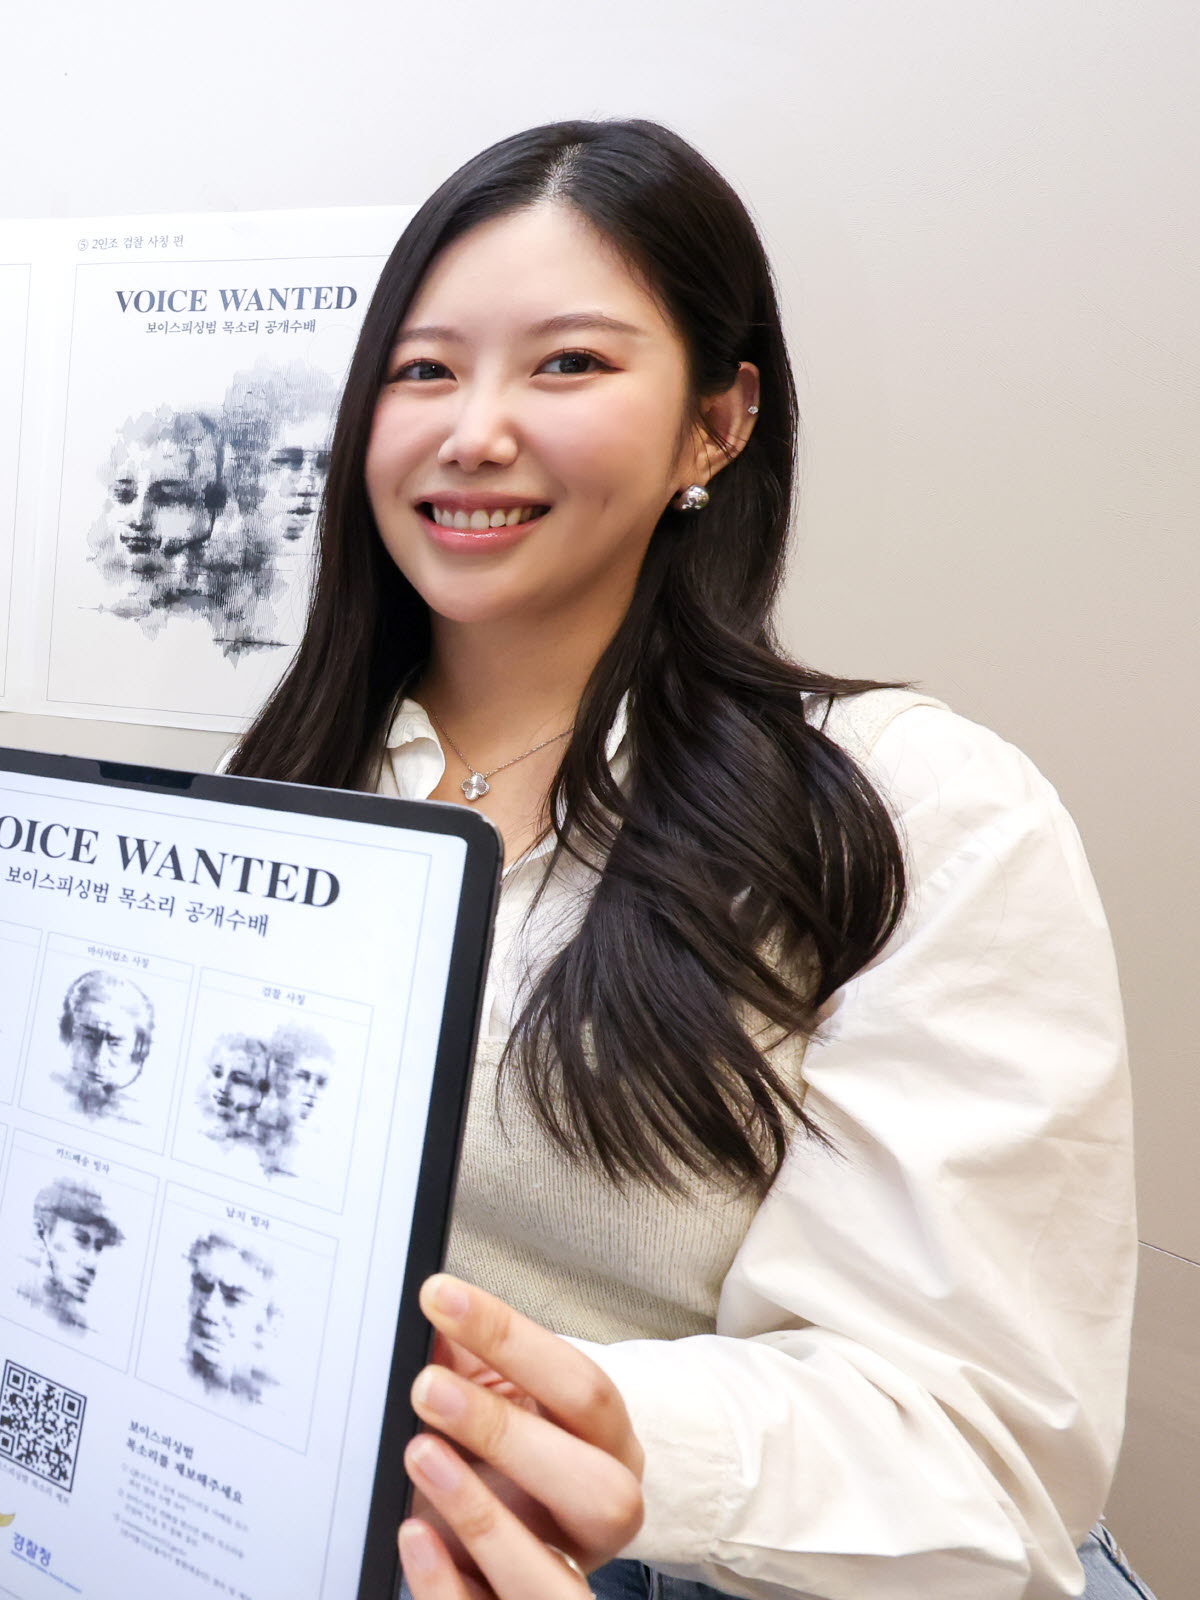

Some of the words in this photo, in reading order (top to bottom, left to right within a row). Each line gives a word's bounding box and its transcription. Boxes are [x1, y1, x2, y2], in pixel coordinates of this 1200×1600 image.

[92, 237, 119, 250] 2인조
[124, 235, 144, 249] 검찰
[148, 234, 169, 248] 사칭
[173, 234, 184, 247] 편
[115, 288, 208, 313] VOICE
[218, 285, 358, 312] WANTED
[145, 320, 217, 336] 보이스피싱범
[222, 320, 260, 335] 목소리
[264, 318, 317, 334] 공개수배
[115, 834, 342, 909] WANTED
[4, 866, 110, 904] 보이스피싱범
[118, 886, 175, 918] 목소리
[184, 901, 269, 938] 공개수배
[128, 1419, 194, 1461] 보이스피싱범
[12, 1531, 52, 1568] 경찰청
